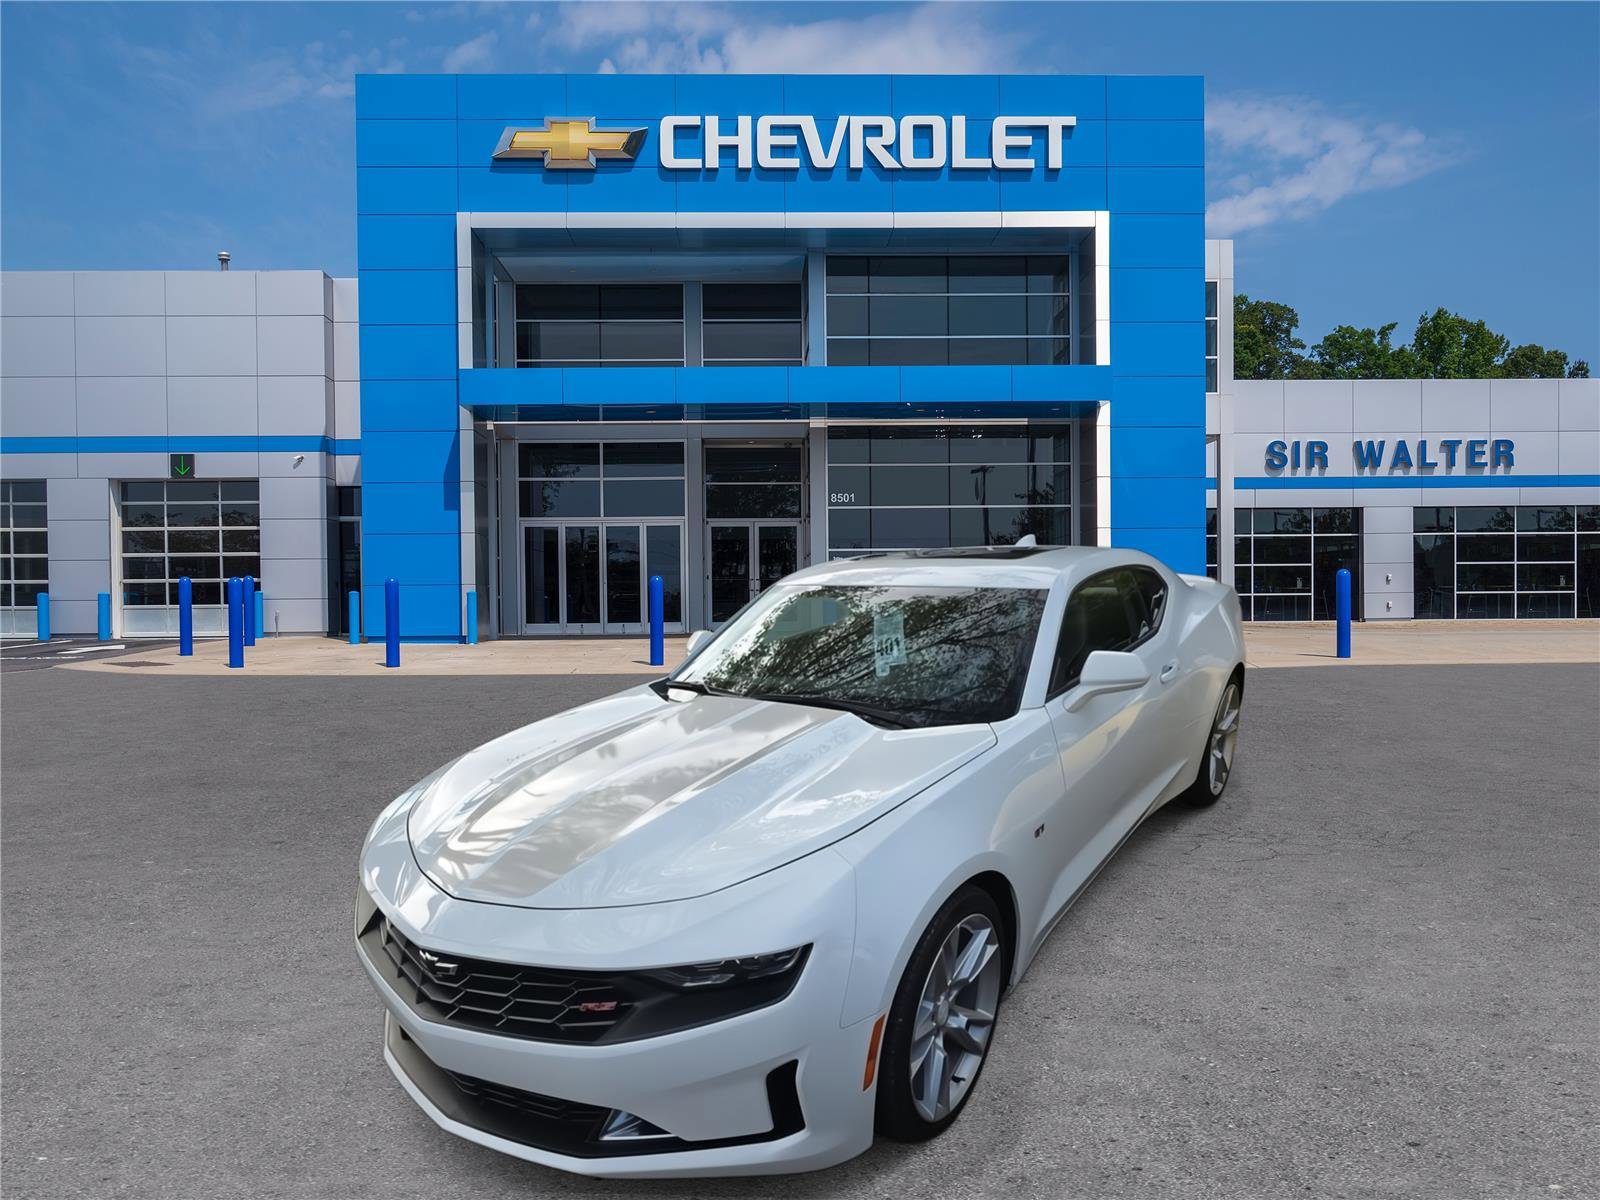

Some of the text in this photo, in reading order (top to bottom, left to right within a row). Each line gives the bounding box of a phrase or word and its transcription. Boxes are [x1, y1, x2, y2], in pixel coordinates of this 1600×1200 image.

[659, 115, 1077, 169] CHEVROLET
[1265, 439, 1515, 470] SIR WALTER
[830, 493, 855, 503] 8501
